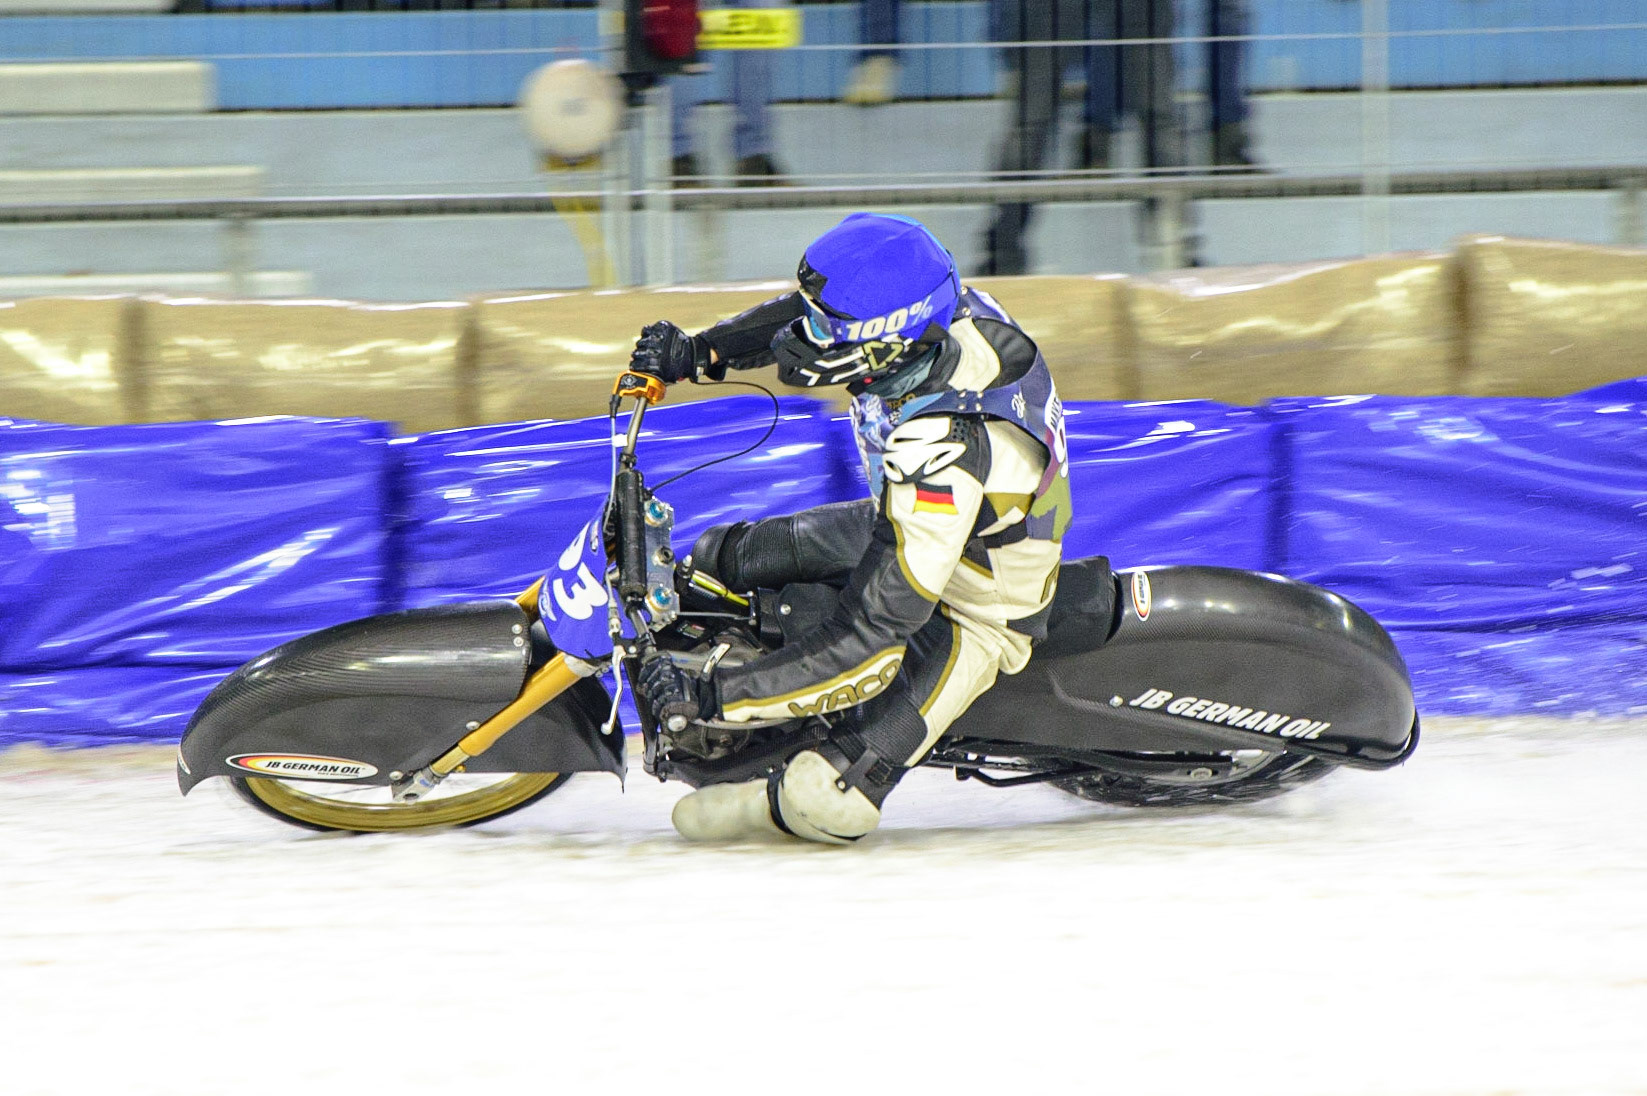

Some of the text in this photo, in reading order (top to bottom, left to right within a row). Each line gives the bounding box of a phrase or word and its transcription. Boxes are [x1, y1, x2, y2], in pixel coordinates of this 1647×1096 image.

[846, 295, 934, 341] 100%
[788, 659, 901, 717] WACO
[1129, 688, 1332, 740] JB GERMAN OIL
[265, 761, 361, 774] JB GERMAN OIL
